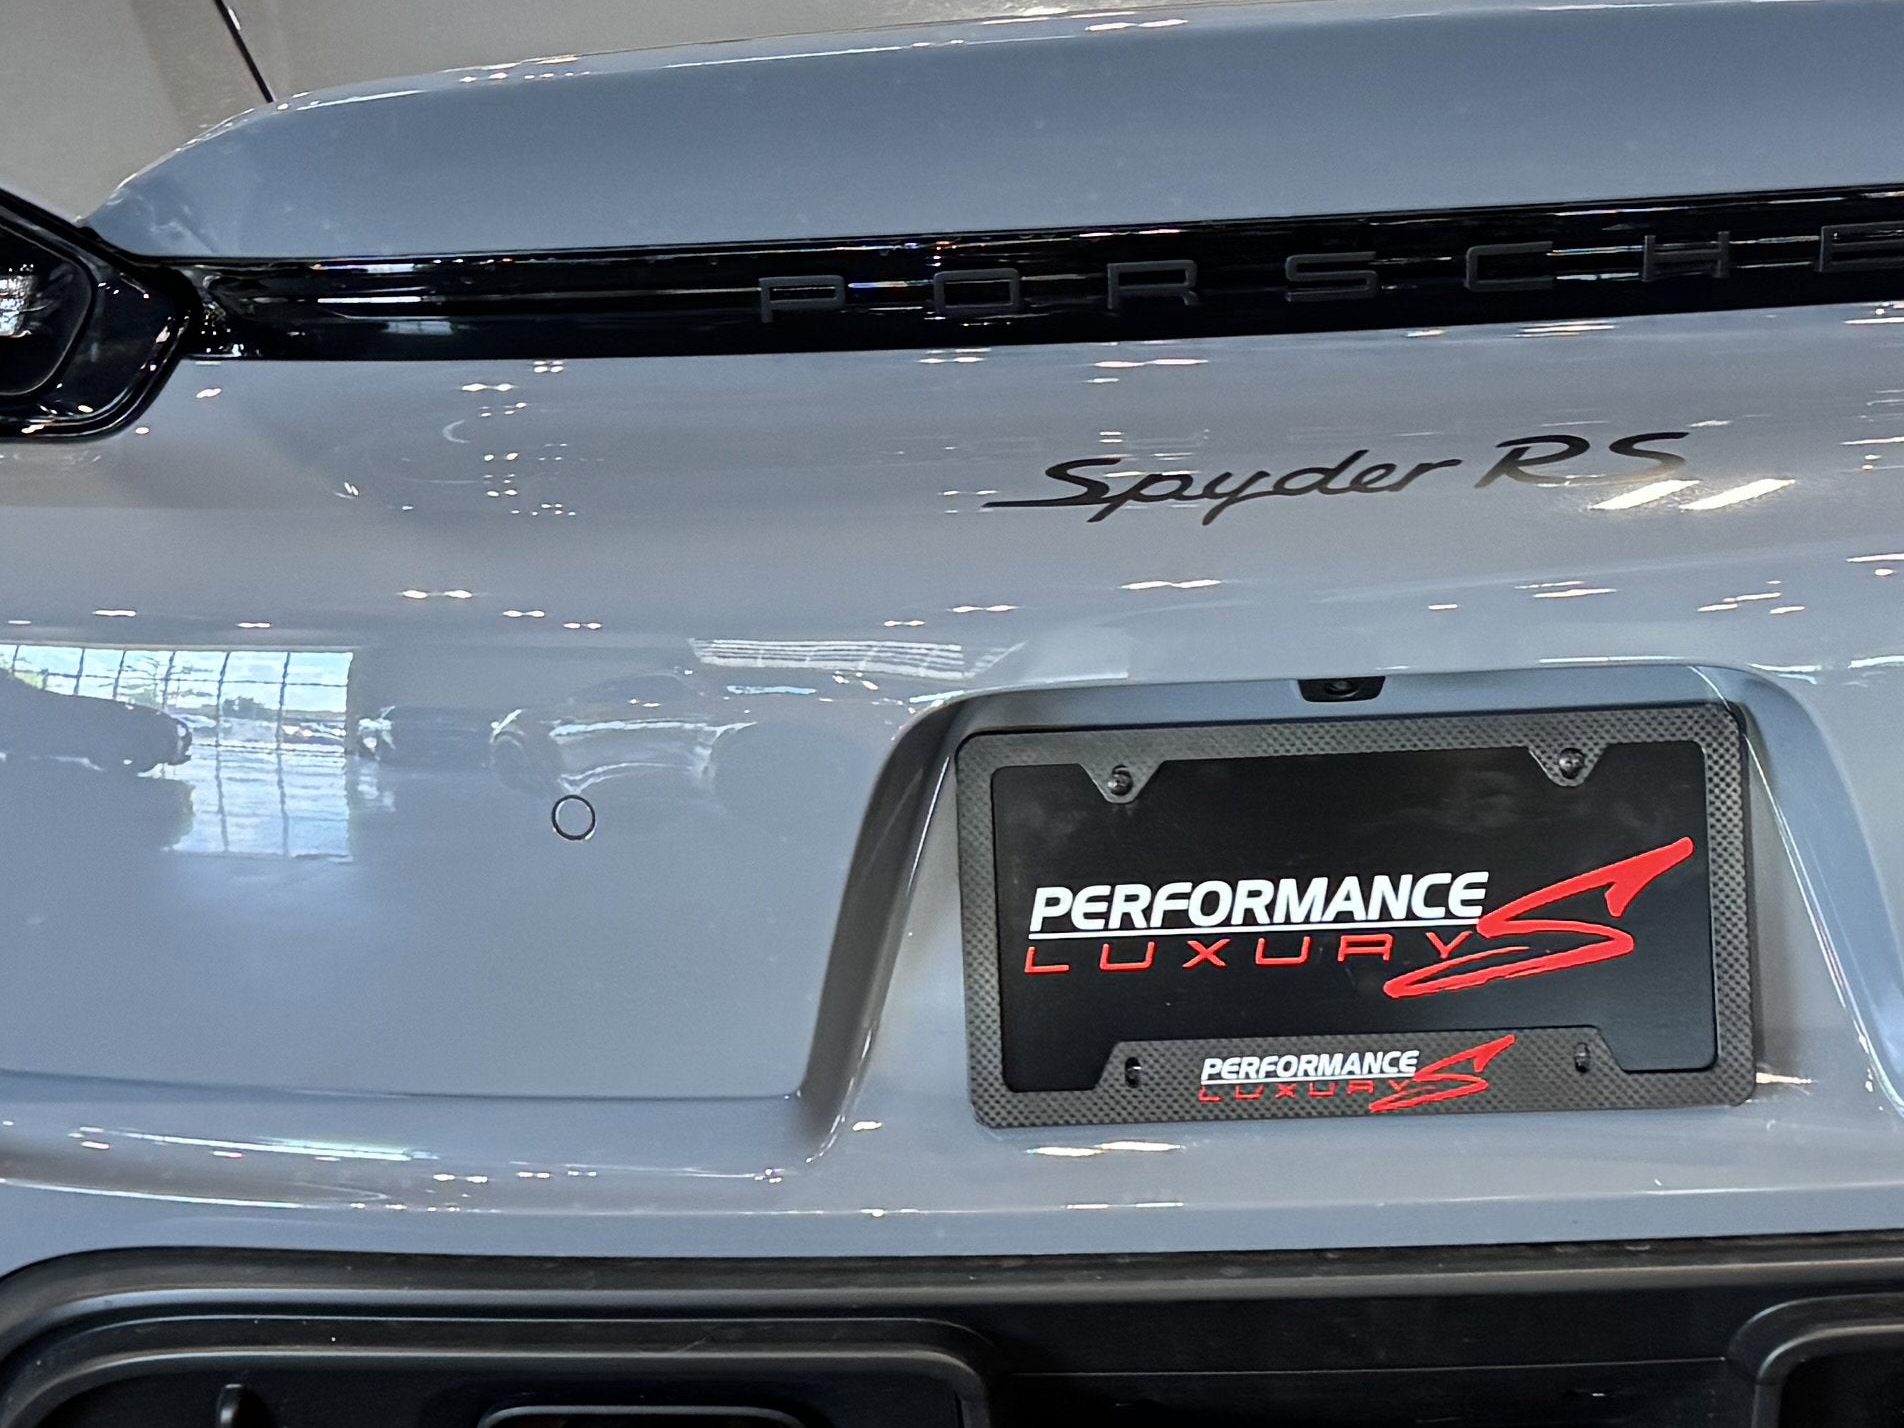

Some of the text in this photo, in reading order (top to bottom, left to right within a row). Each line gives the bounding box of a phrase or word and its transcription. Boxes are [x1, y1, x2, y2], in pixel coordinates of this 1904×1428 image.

[983, 432, 1690, 525] Spyder RS
[1030, 872, 1489, 932] PERFORMANCE
[1025, 931, 1473, 975] LUXURY
[1201, 1050, 1419, 1081] PERFORMANCE
[1199, 1079, 1415, 1103] LUXURY
